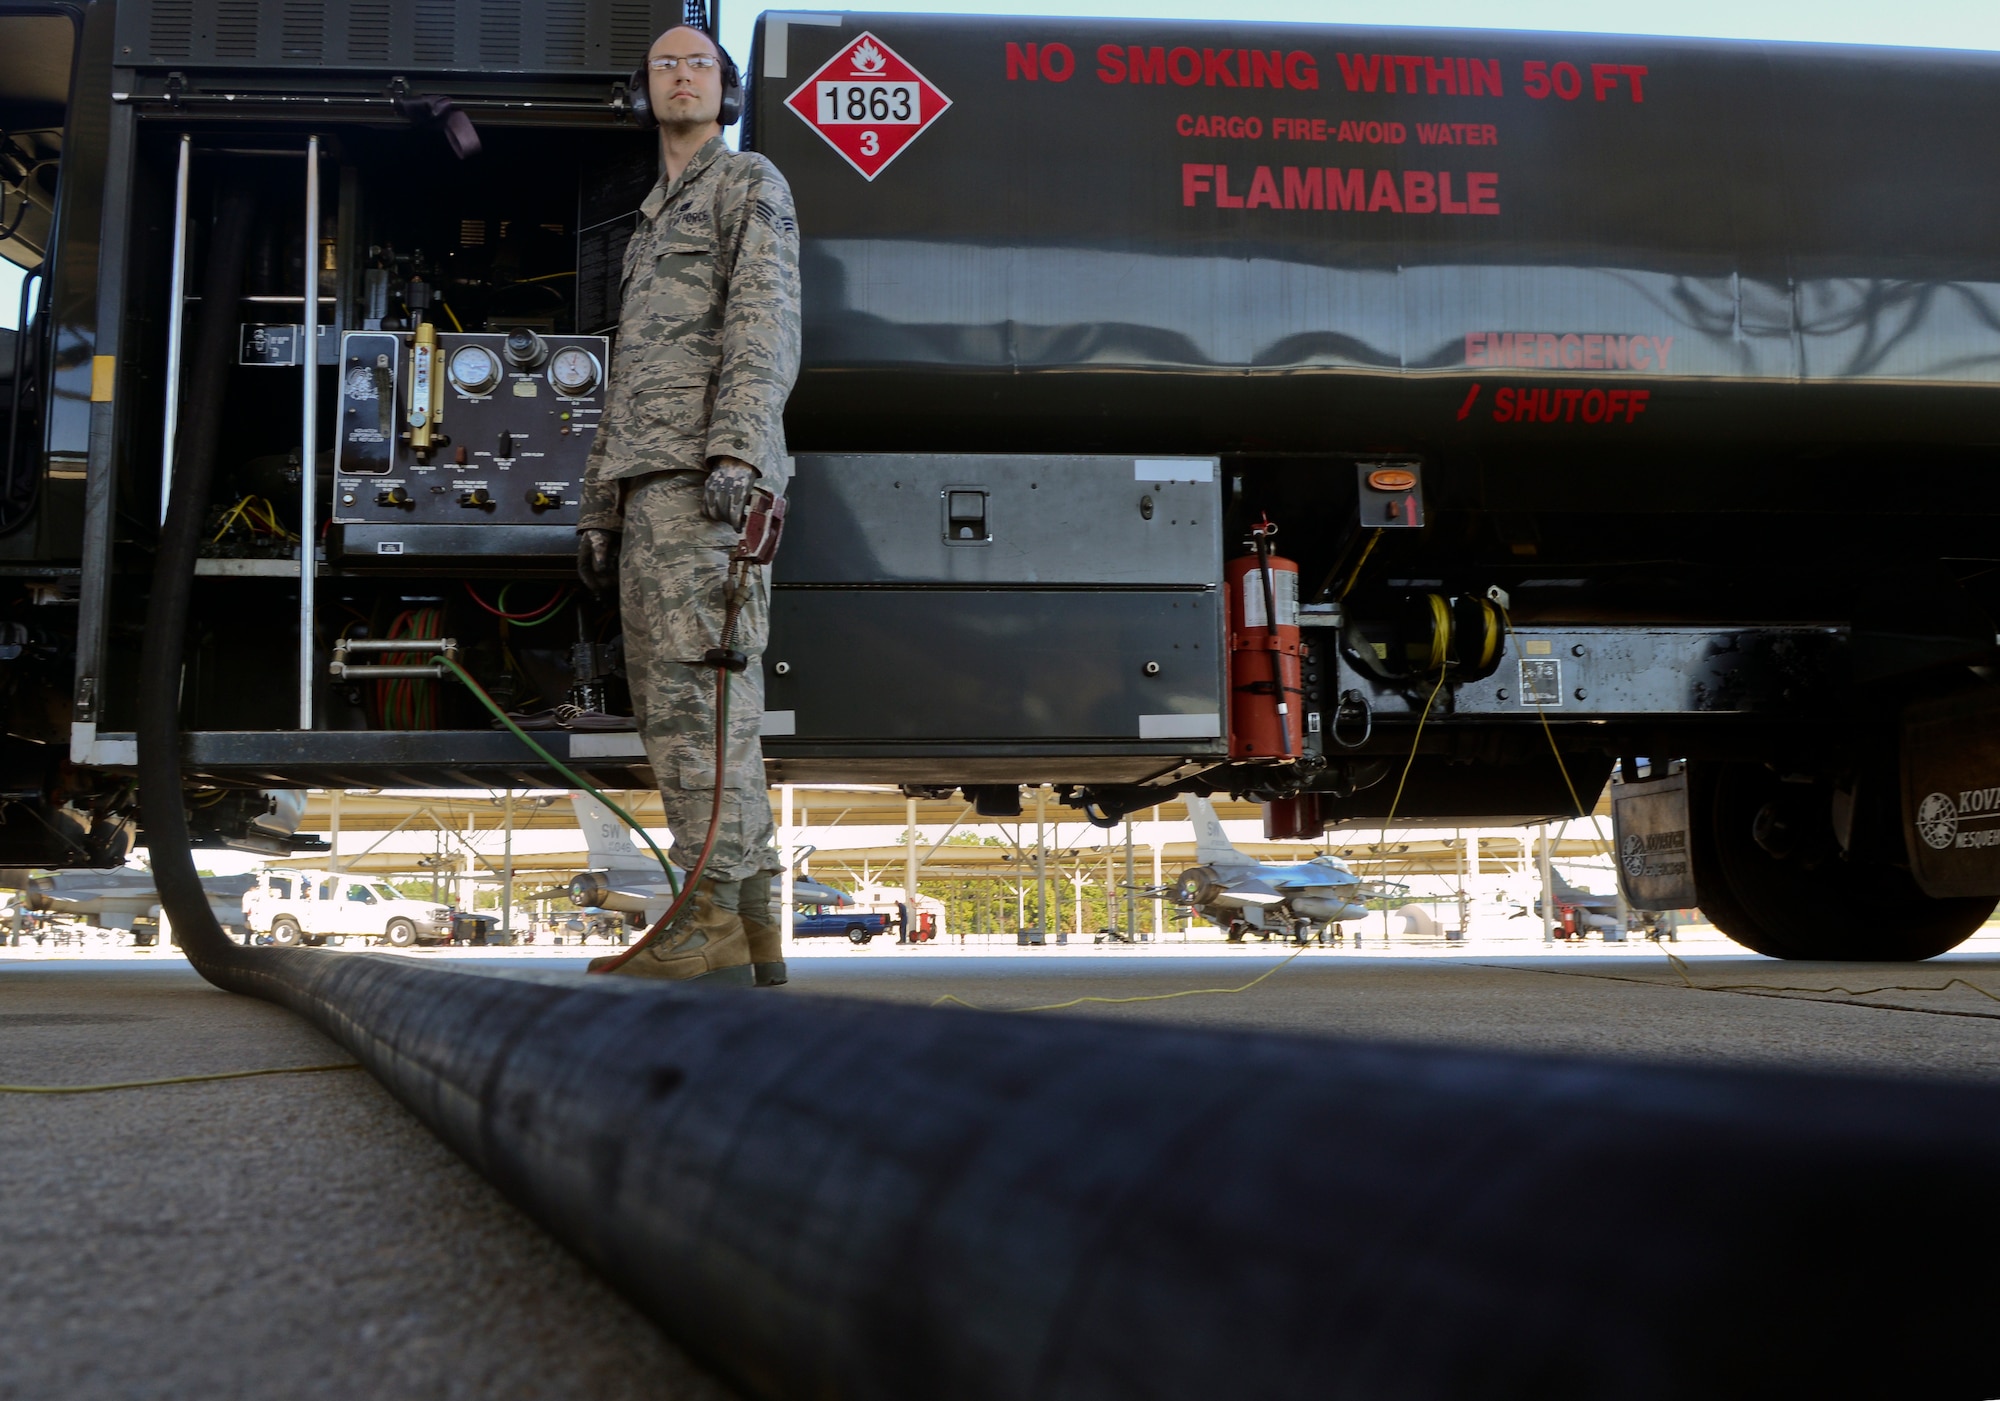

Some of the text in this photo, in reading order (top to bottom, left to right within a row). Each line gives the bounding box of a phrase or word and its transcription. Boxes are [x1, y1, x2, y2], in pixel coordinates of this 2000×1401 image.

[1005, 42, 1649, 104] NO SMOKING WITHIN 50 FT
[825, 87, 911, 121] 1863
[859, 130, 881, 157] 3
[1176, 113, 1498, 147] CARGO FIRE-AVOID WATER
[1182, 163, 1501, 216] FLAMMABLE
[1465, 332, 1673, 370] EMERGENCY
[1492, 387, 1650, 424] SHUTOFF
[601, 824, 620, 839] SW
